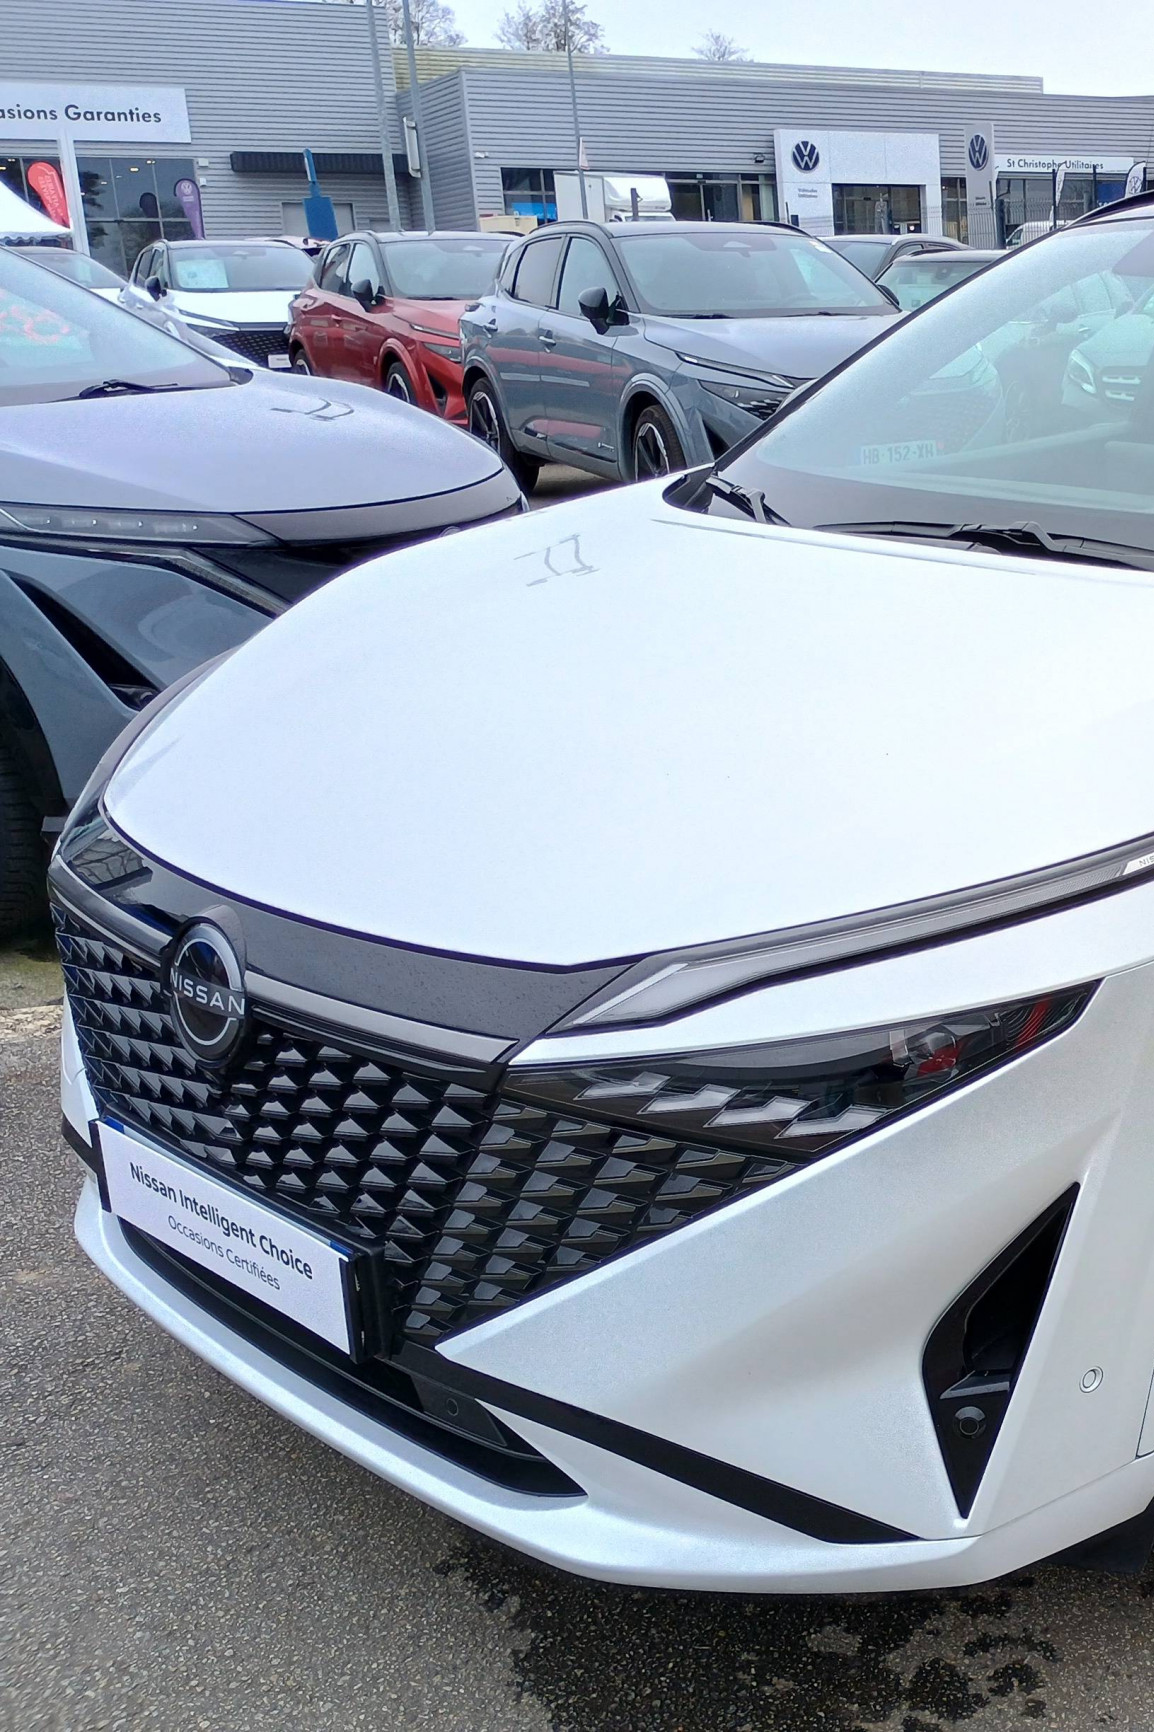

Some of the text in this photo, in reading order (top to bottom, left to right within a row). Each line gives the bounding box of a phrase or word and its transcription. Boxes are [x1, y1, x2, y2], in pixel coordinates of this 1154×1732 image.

[65, 105, 161, 122] Garanties
[1007, 158, 1015, 167] St
[1065, 160, 1104, 169] Utilitaies
[170, 967, 245, 1015] NISSAN
[129, 1162, 313, 1280] Nissan Intelligent Choice
[168, 1215, 281, 1290] Occasions Certifiées
